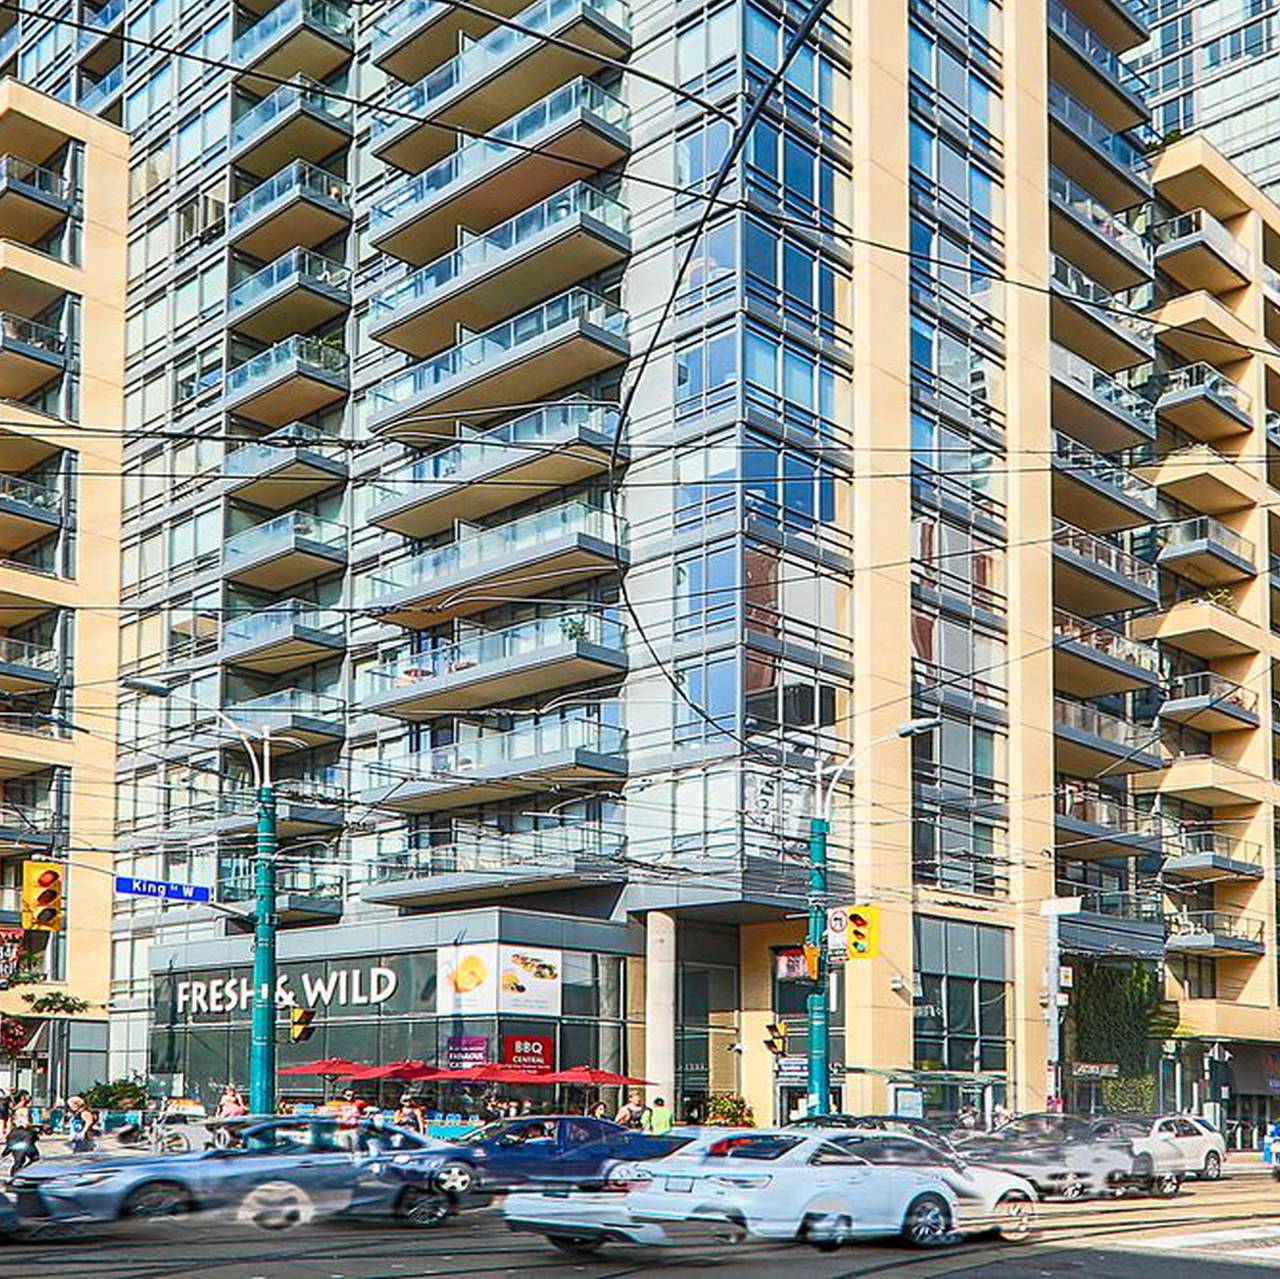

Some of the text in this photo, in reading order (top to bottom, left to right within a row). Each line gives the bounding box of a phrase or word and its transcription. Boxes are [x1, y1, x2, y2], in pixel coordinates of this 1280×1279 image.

[132, 879, 166, 898] King
[182, 885, 195, 898] W
[275, 974, 299, 1008] &
[301, 967, 397, 1008] WILD
[514, 1040, 543, 1055] BBQ
